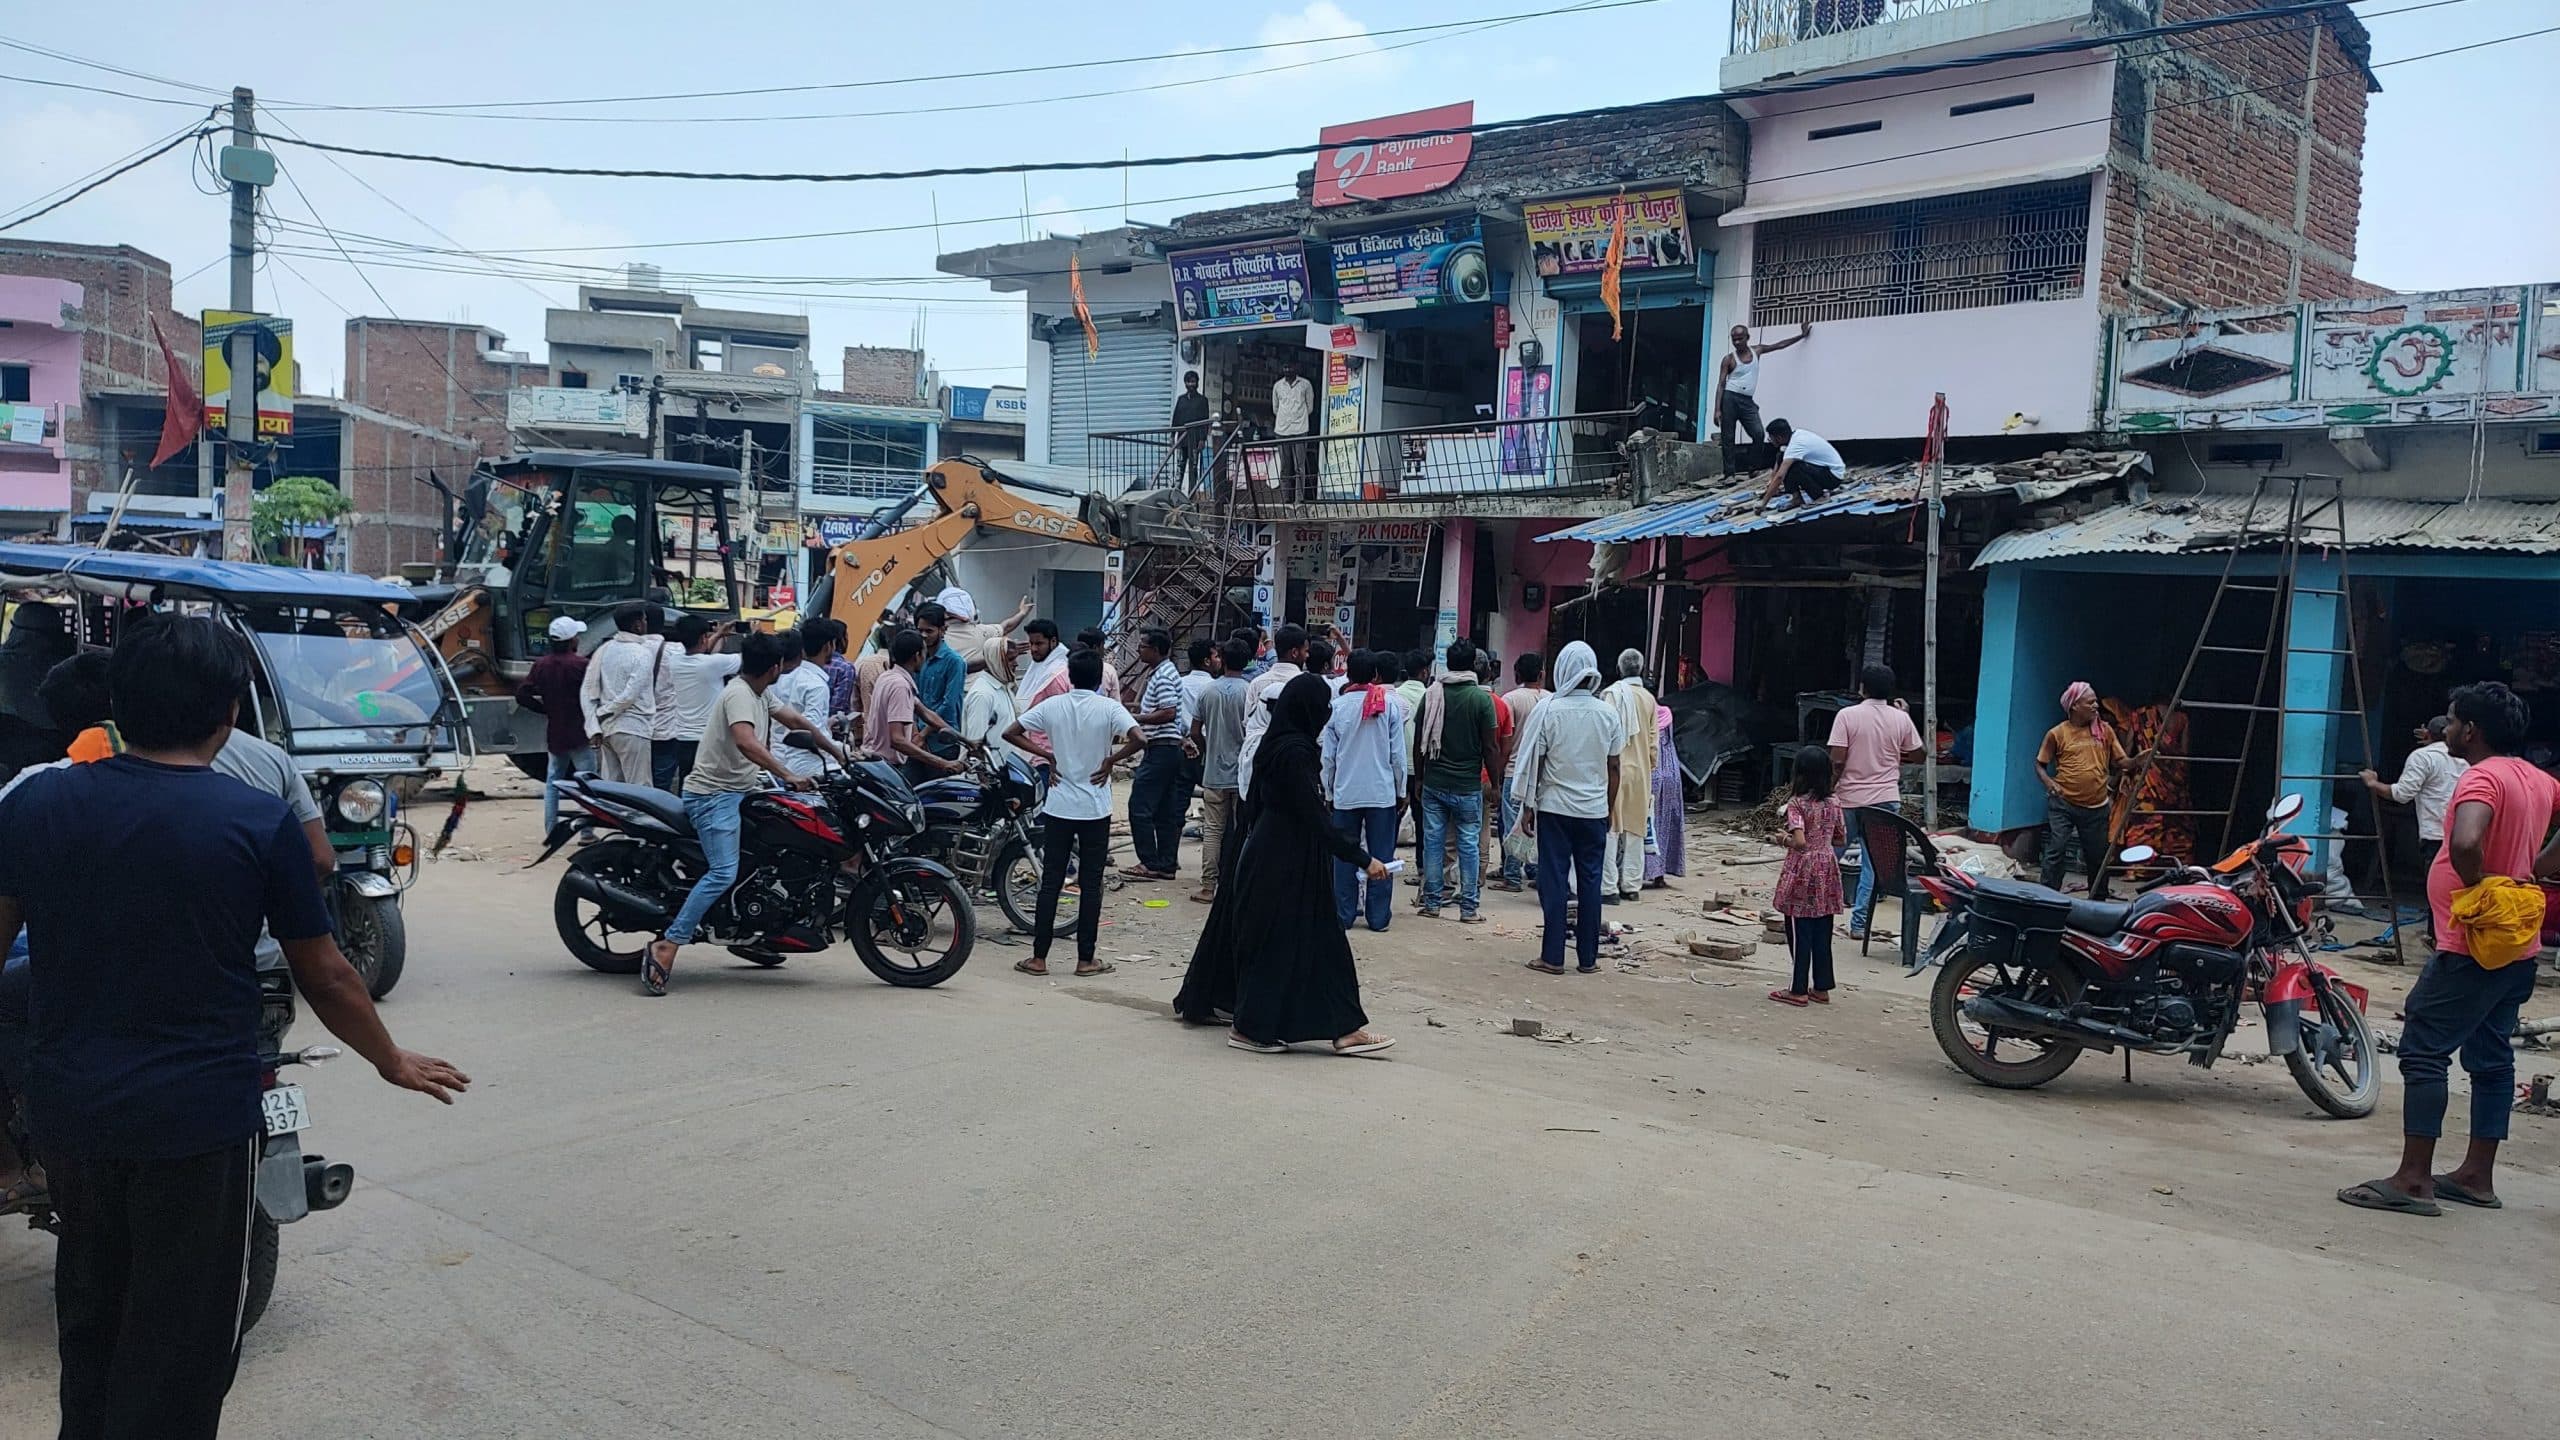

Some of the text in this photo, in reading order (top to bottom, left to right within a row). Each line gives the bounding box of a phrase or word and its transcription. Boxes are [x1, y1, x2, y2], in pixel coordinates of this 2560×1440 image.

[1378, 134, 1454, 157] Payments
[1376, 156, 1416, 177] Bank
[1331, 241, 1358, 261] गुप्ता
[996, 399, 1018, 410] KSB
[824, 520, 853, 535] ZARA
[1014, 508, 1078, 535] CASE
[851, 554, 899, 606] 770 EX
